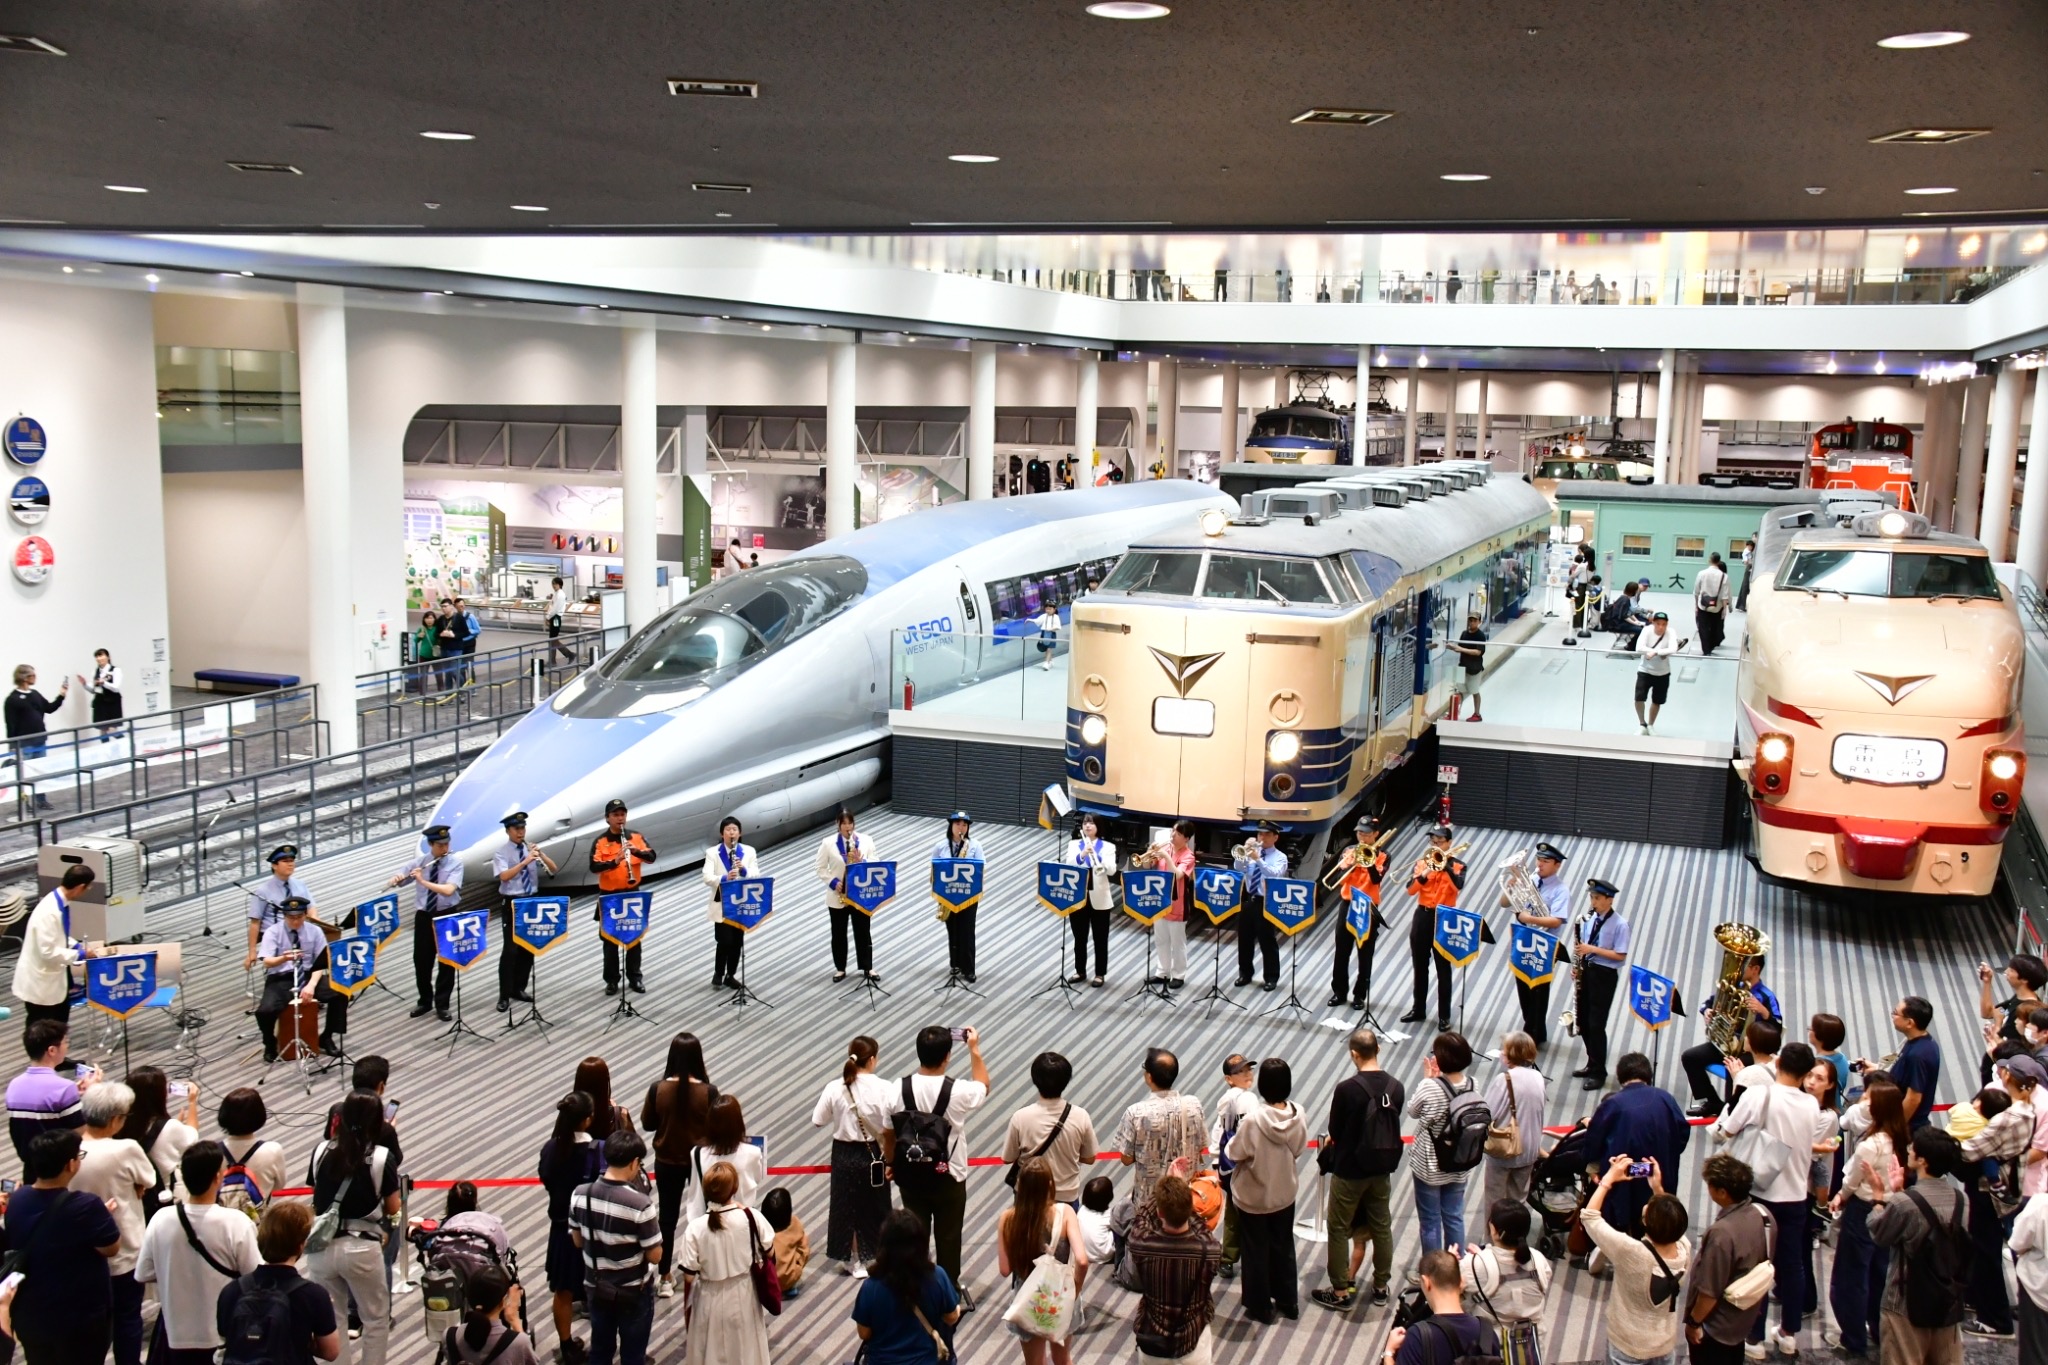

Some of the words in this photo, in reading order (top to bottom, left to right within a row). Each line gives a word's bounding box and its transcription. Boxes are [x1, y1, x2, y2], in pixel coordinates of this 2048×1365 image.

[1669, 573, 1685, 589] 大
[906, 642, 928, 655] WEST
[931, 636, 954, 649] JAPAN
[854, 867, 888, 887] JR
[940, 864, 975, 882] JR
[1046, 869, 1079, 890] JR
[731, 883, 764, 904] JR
[1132, 876, 1165, 896] JR
[1203, 874, 1235, 894] JR
[1273, 884, 1307, 904] JR
[364, 901, 393, 926] JR
[524, 903, 560, 923] JR
[610, 897, 643, 919] JR
[446, 916, 481, 942] JR
[1443, 915, 1475, 940] JR
[337, 941, 369, 966] JR
[1516, 933, 1549, 960] JR
[99, 958, 147, 987] JR
[1637, 977, 1667, 1005] JR
